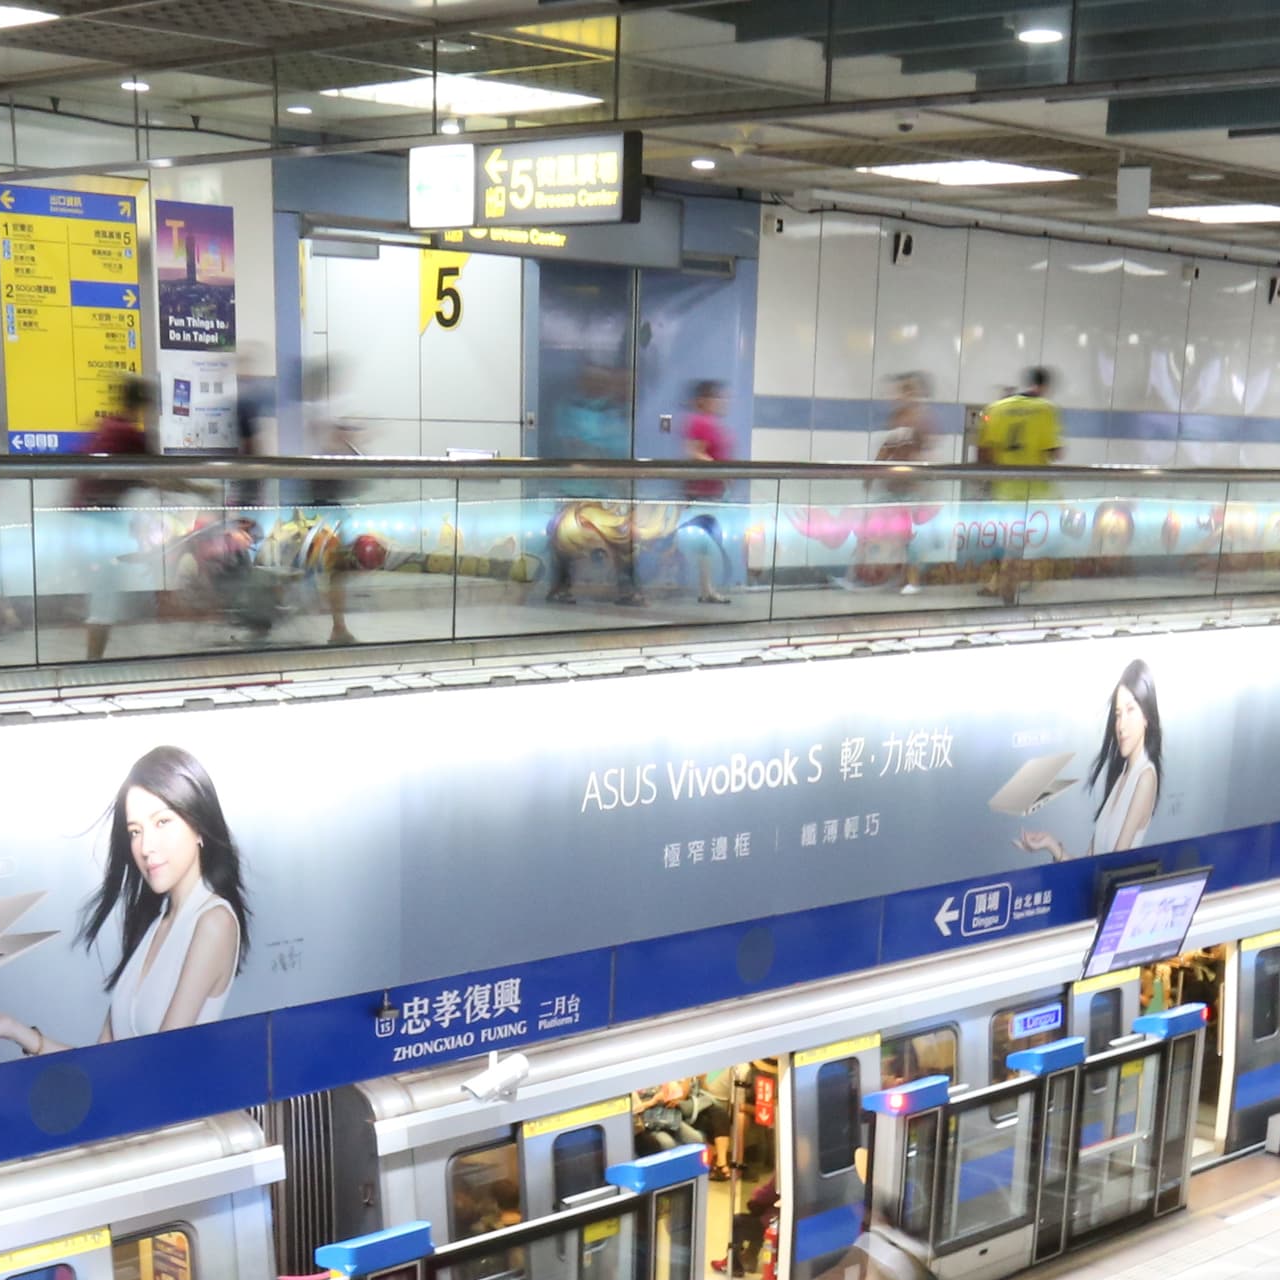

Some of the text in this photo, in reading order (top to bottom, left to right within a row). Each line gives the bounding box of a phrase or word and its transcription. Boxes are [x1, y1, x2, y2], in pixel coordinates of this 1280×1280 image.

[509, 158, 535, 210] 5
[2, 222, 9, 236] 1
[123, 231, 132, 246] 5
[5, 283, 15, 299] 2
[435, 266, 461, 328] 5
[126, 313, 135, 328] 3
[168, 315, 185, 327] Fun
[186, 316, 214, 331] Things
[169, 329, 181, 341] Do
[192, 331, 219, 344] Taipei
[580, 763, 658, 813] ASUS
[666, 748, 799, 801] VivoBook
[807, 744, 823, 784] S
[663, 831, 752, 870] 極窄邊框
[400, 977, 581, 1036] 忠孝復興 二月台
[379, 1021, 391, 1034] 15
[538, 1017, 573, 1032] Platform
[392, 1020, 527, 1063] ZHONGXIAO FUXING
